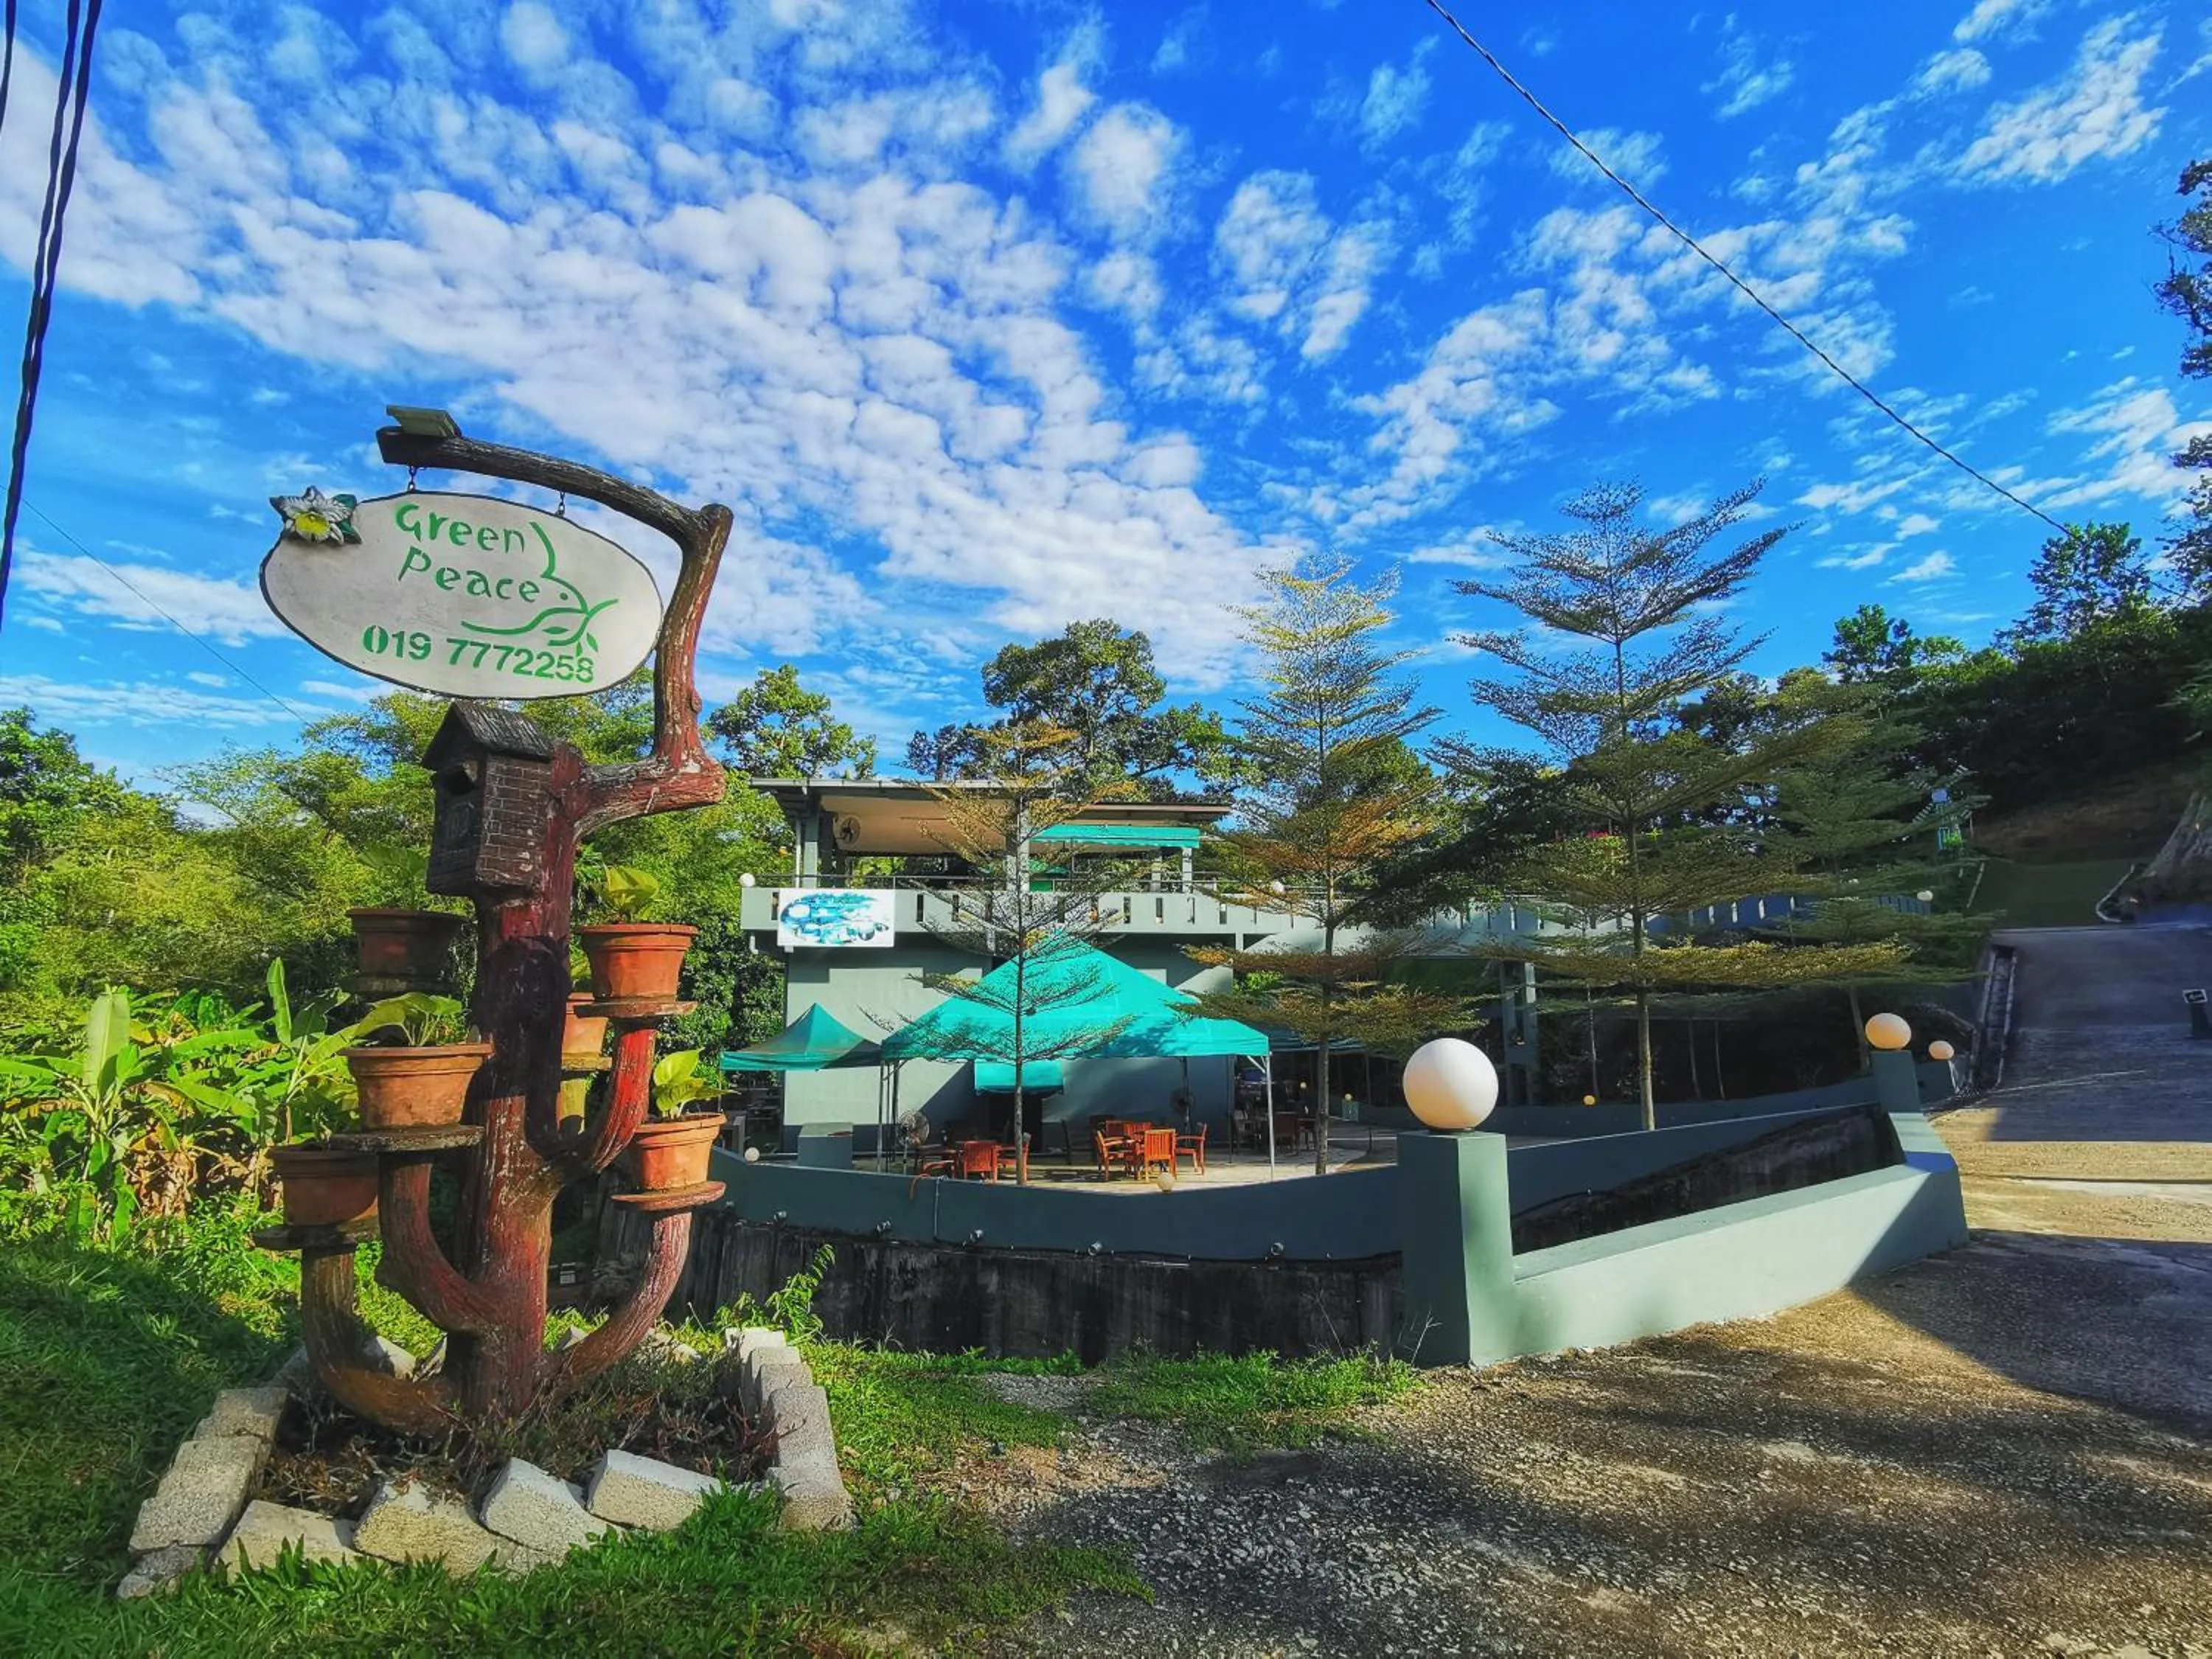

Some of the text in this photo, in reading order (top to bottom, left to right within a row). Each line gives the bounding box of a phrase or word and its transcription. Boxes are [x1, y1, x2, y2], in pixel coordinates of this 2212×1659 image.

[394, 503, 525, 553] Green
[397, 546, 540, 603] Peace
[362, 625, 595, 684] 019 7772258
